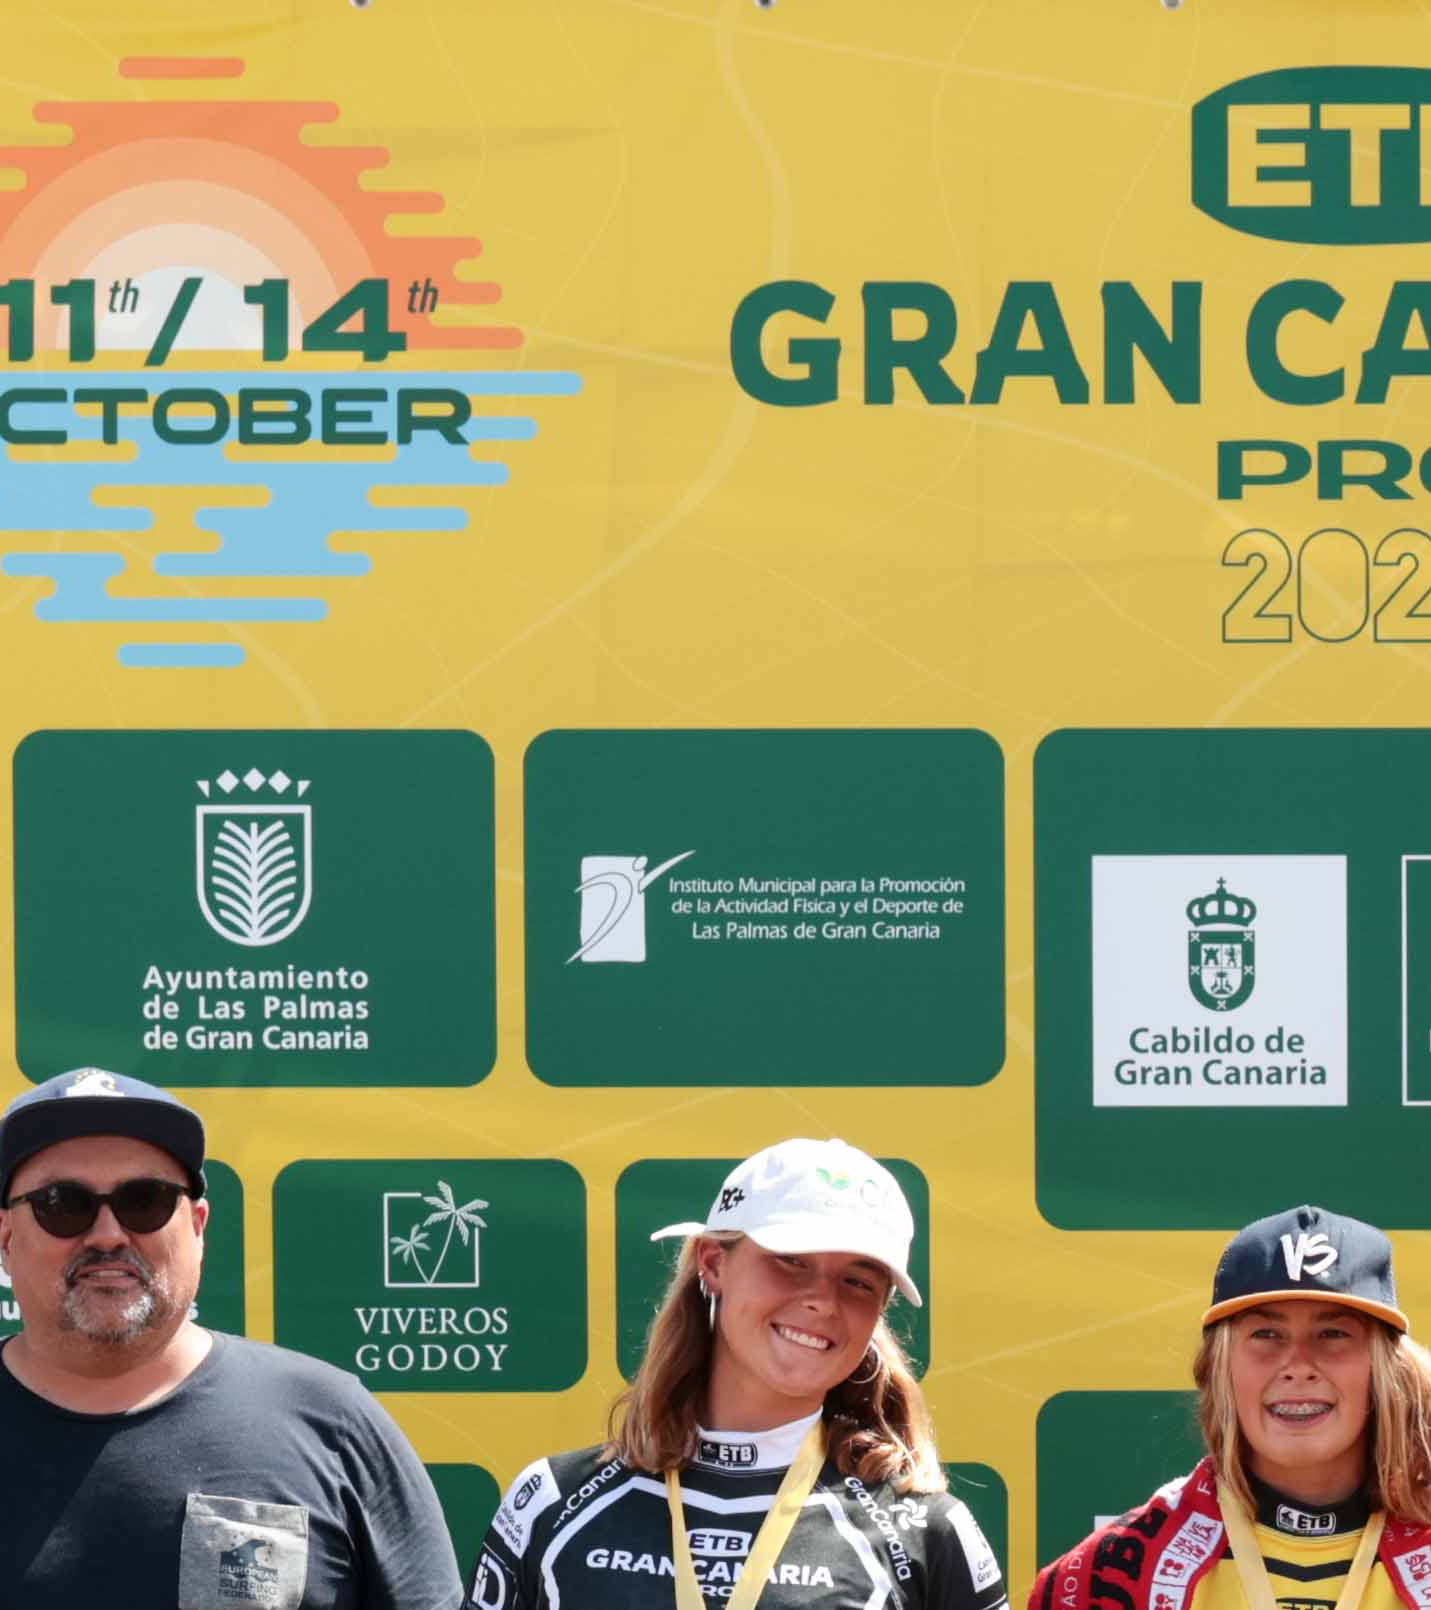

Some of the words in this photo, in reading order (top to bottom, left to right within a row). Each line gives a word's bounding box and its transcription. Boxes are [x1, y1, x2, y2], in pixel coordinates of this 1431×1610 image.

[729, 279, 1203, 407] GRAN
[669, 877, 733, 893] Instituto
[738, 877, 816, 895] Municipal
[820, 880, 856, 895] para
[861, 877, 874, 892] la
[879, 877, 965, 892] Promoción
[692, 923, 720, 939] Las
[726, 923, 787, 939] Palmas
[794, 923, 816, 939] de
[822, 923, 866, 939] Gran
[872, 923, 939, 939] Canaria
[143, 965, 369, 995] Ayuntamiento
[143, 996, 180, 1020] de
[197, 996, 246, 1020] Las
[263, 996, 368, 1020] Palmas
[143, 1025, 178, 1050] de
[186, 1025, 252, 1050] Gran
[261, 1025, 369, 1050] Canaria
[1129, 1026, 1255, 1054] Cabildo
[1265, 1026, 1304, 1054] de
[1114, 1059, 1192, 1086] Gran
[1202, 1059, 1327, 1086] Canaria
[1279, 1232, 1337, 1280] VS
[354, 1306, 508, 1335] VIVEROS
[356, 1343, 508, 1372] GODOY
[719, 1444, 752, 1462] ETB
[1297, 1514, 1330, 1529] ETB
[689, 1533, 743, 1551] ETB
